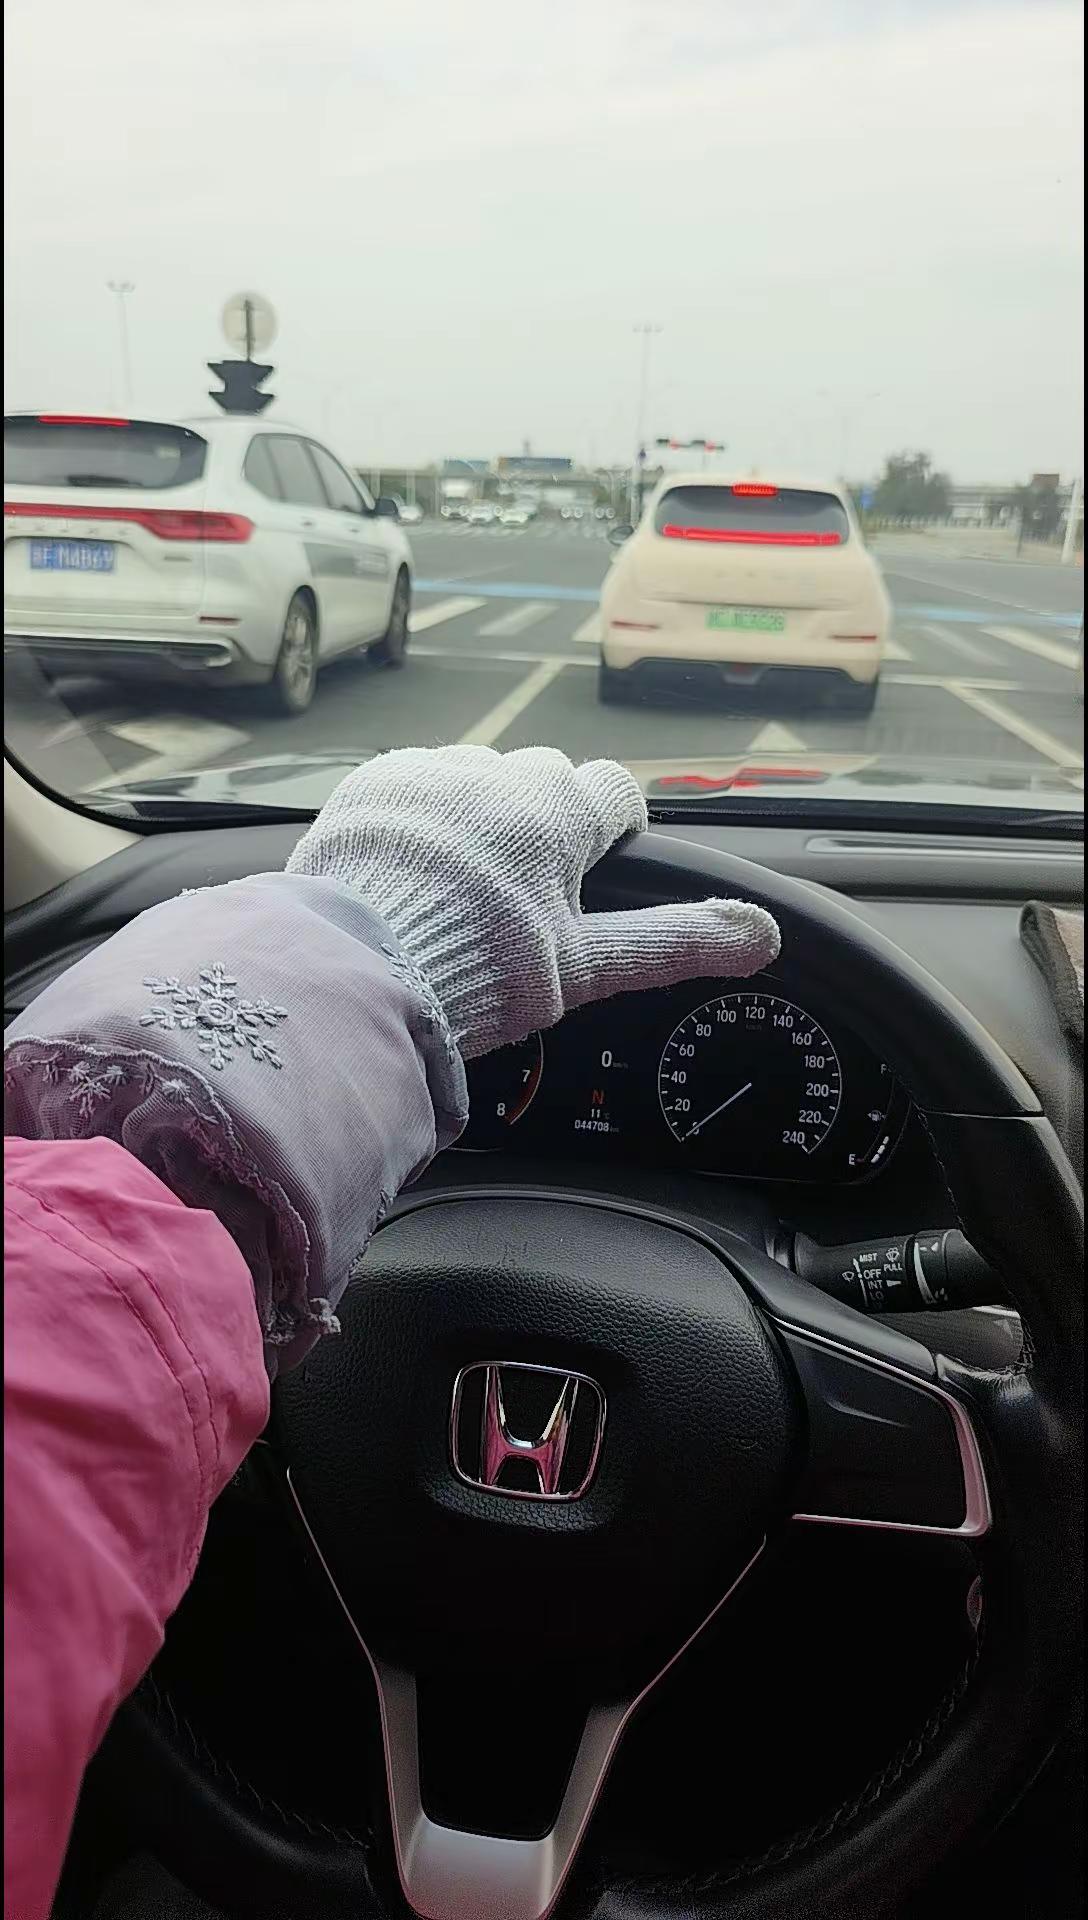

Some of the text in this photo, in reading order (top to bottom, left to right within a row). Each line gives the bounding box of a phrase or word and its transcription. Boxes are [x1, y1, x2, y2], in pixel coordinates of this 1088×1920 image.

[716, 1010, 737, 1023] 100
[745, 1006, 766, 1020] 120
[772, 1014, 794, 1029] 140
[695, 1025, 712, 1037] 80
[791, 1032, 812, 1046] 160
[679, 1044, 695, 1057] 60
[601, 1051, 613, 1068] 0
[804, 1055, 825, 1069] 180
[522, 1069, 531, 1083] 7
[671, 1071, 687, 1084] 40
[806, 1083, 829, 1097] 200
[592, 1090, 604, 1105] N
[496, 1103, 506, 1117] 8
[674, 1098, 691, 1112] 20
[799, 1110, 821, 1124] 220
[574, 1119, 610, 1132] 044708
[782, 1130, 805, 1144] 240
[848, 1153, 856, 1165] E
[859, 1252, 878, 1262] MIST
[863, 1268, 882, 1279] OFF
[883, 1263, 903, 1272] PULL
[868, 1280, 883, 1290] INT
